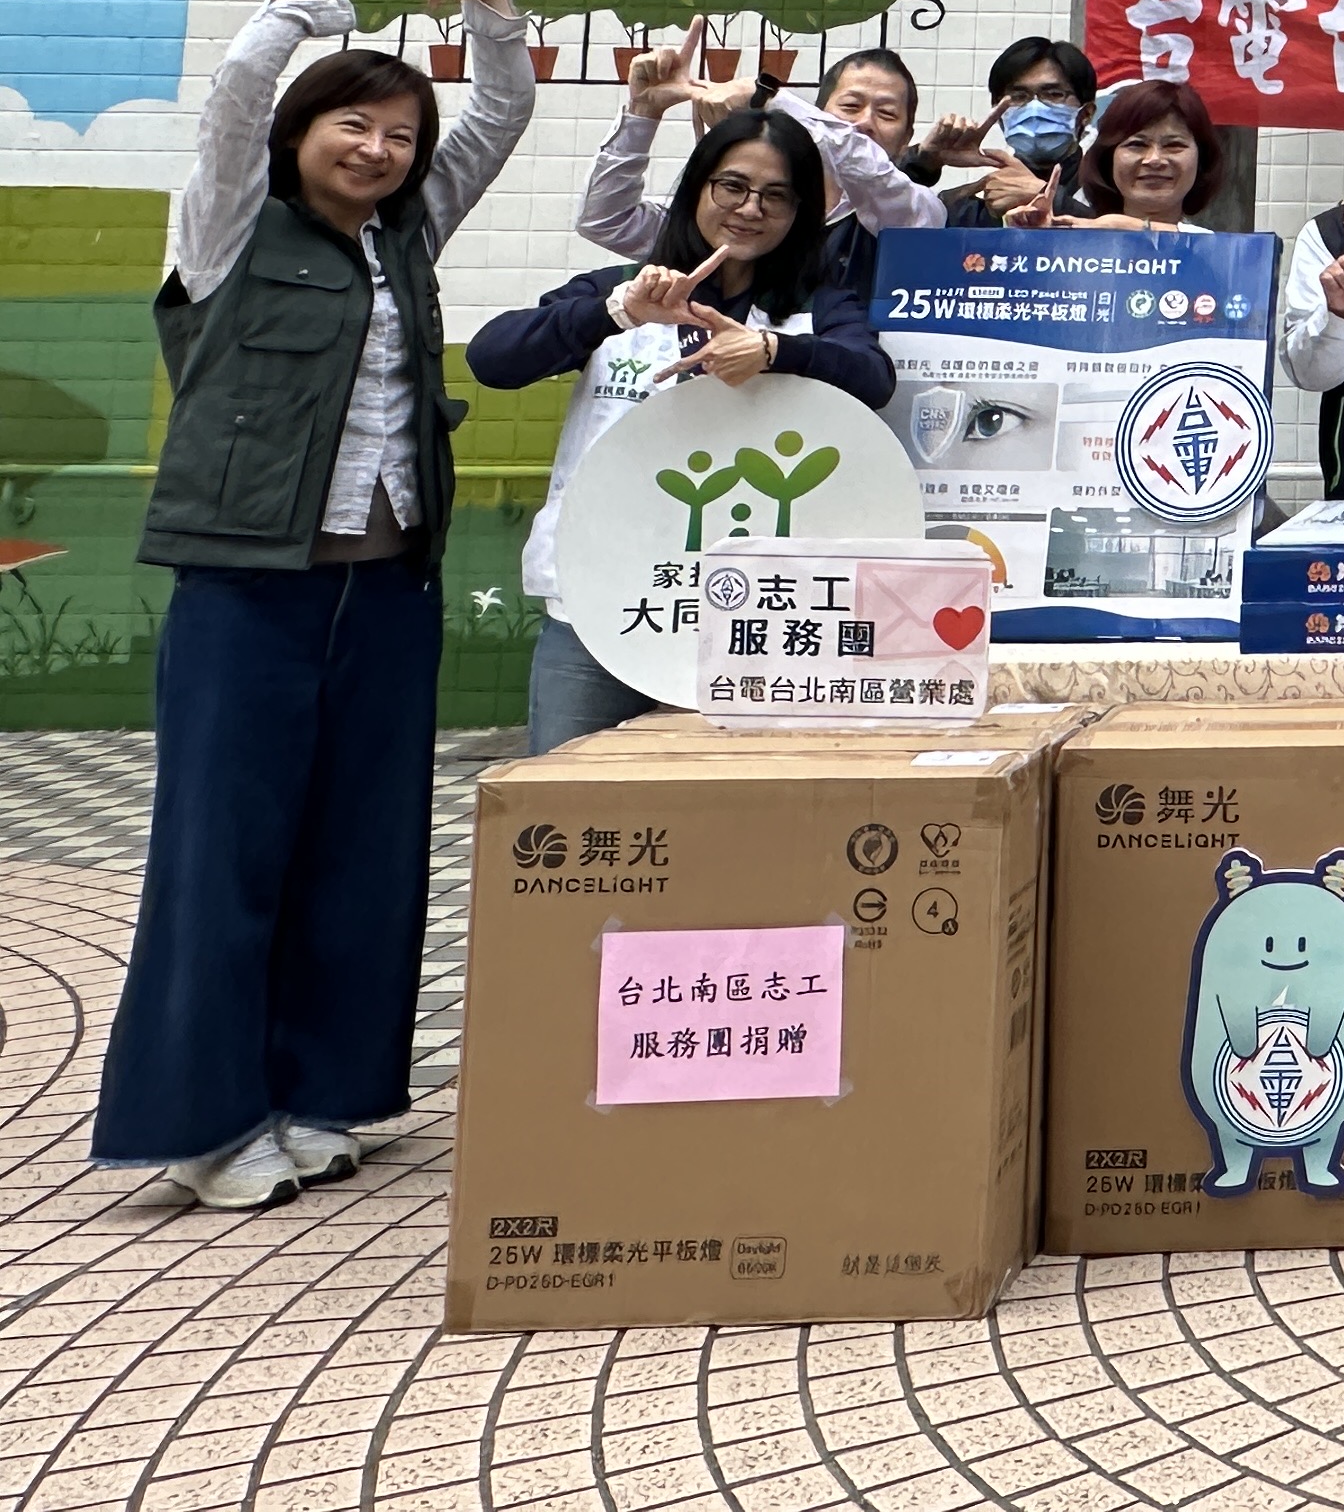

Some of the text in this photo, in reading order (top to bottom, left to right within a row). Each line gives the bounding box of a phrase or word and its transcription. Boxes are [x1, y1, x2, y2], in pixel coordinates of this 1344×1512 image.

[757, 574, 851, 612] 志工
[728, 620, 874, 657] 服務團
[709, 675, 974, 706] 台電台北南區營業處
[1157, 786, 1239, 824] 舞光
[578, 826, 670, 868] 舞光
[617, 973, 829, 1007] 台北南區志工
[630, 1023, 808, 1059] 服務團捐贈
